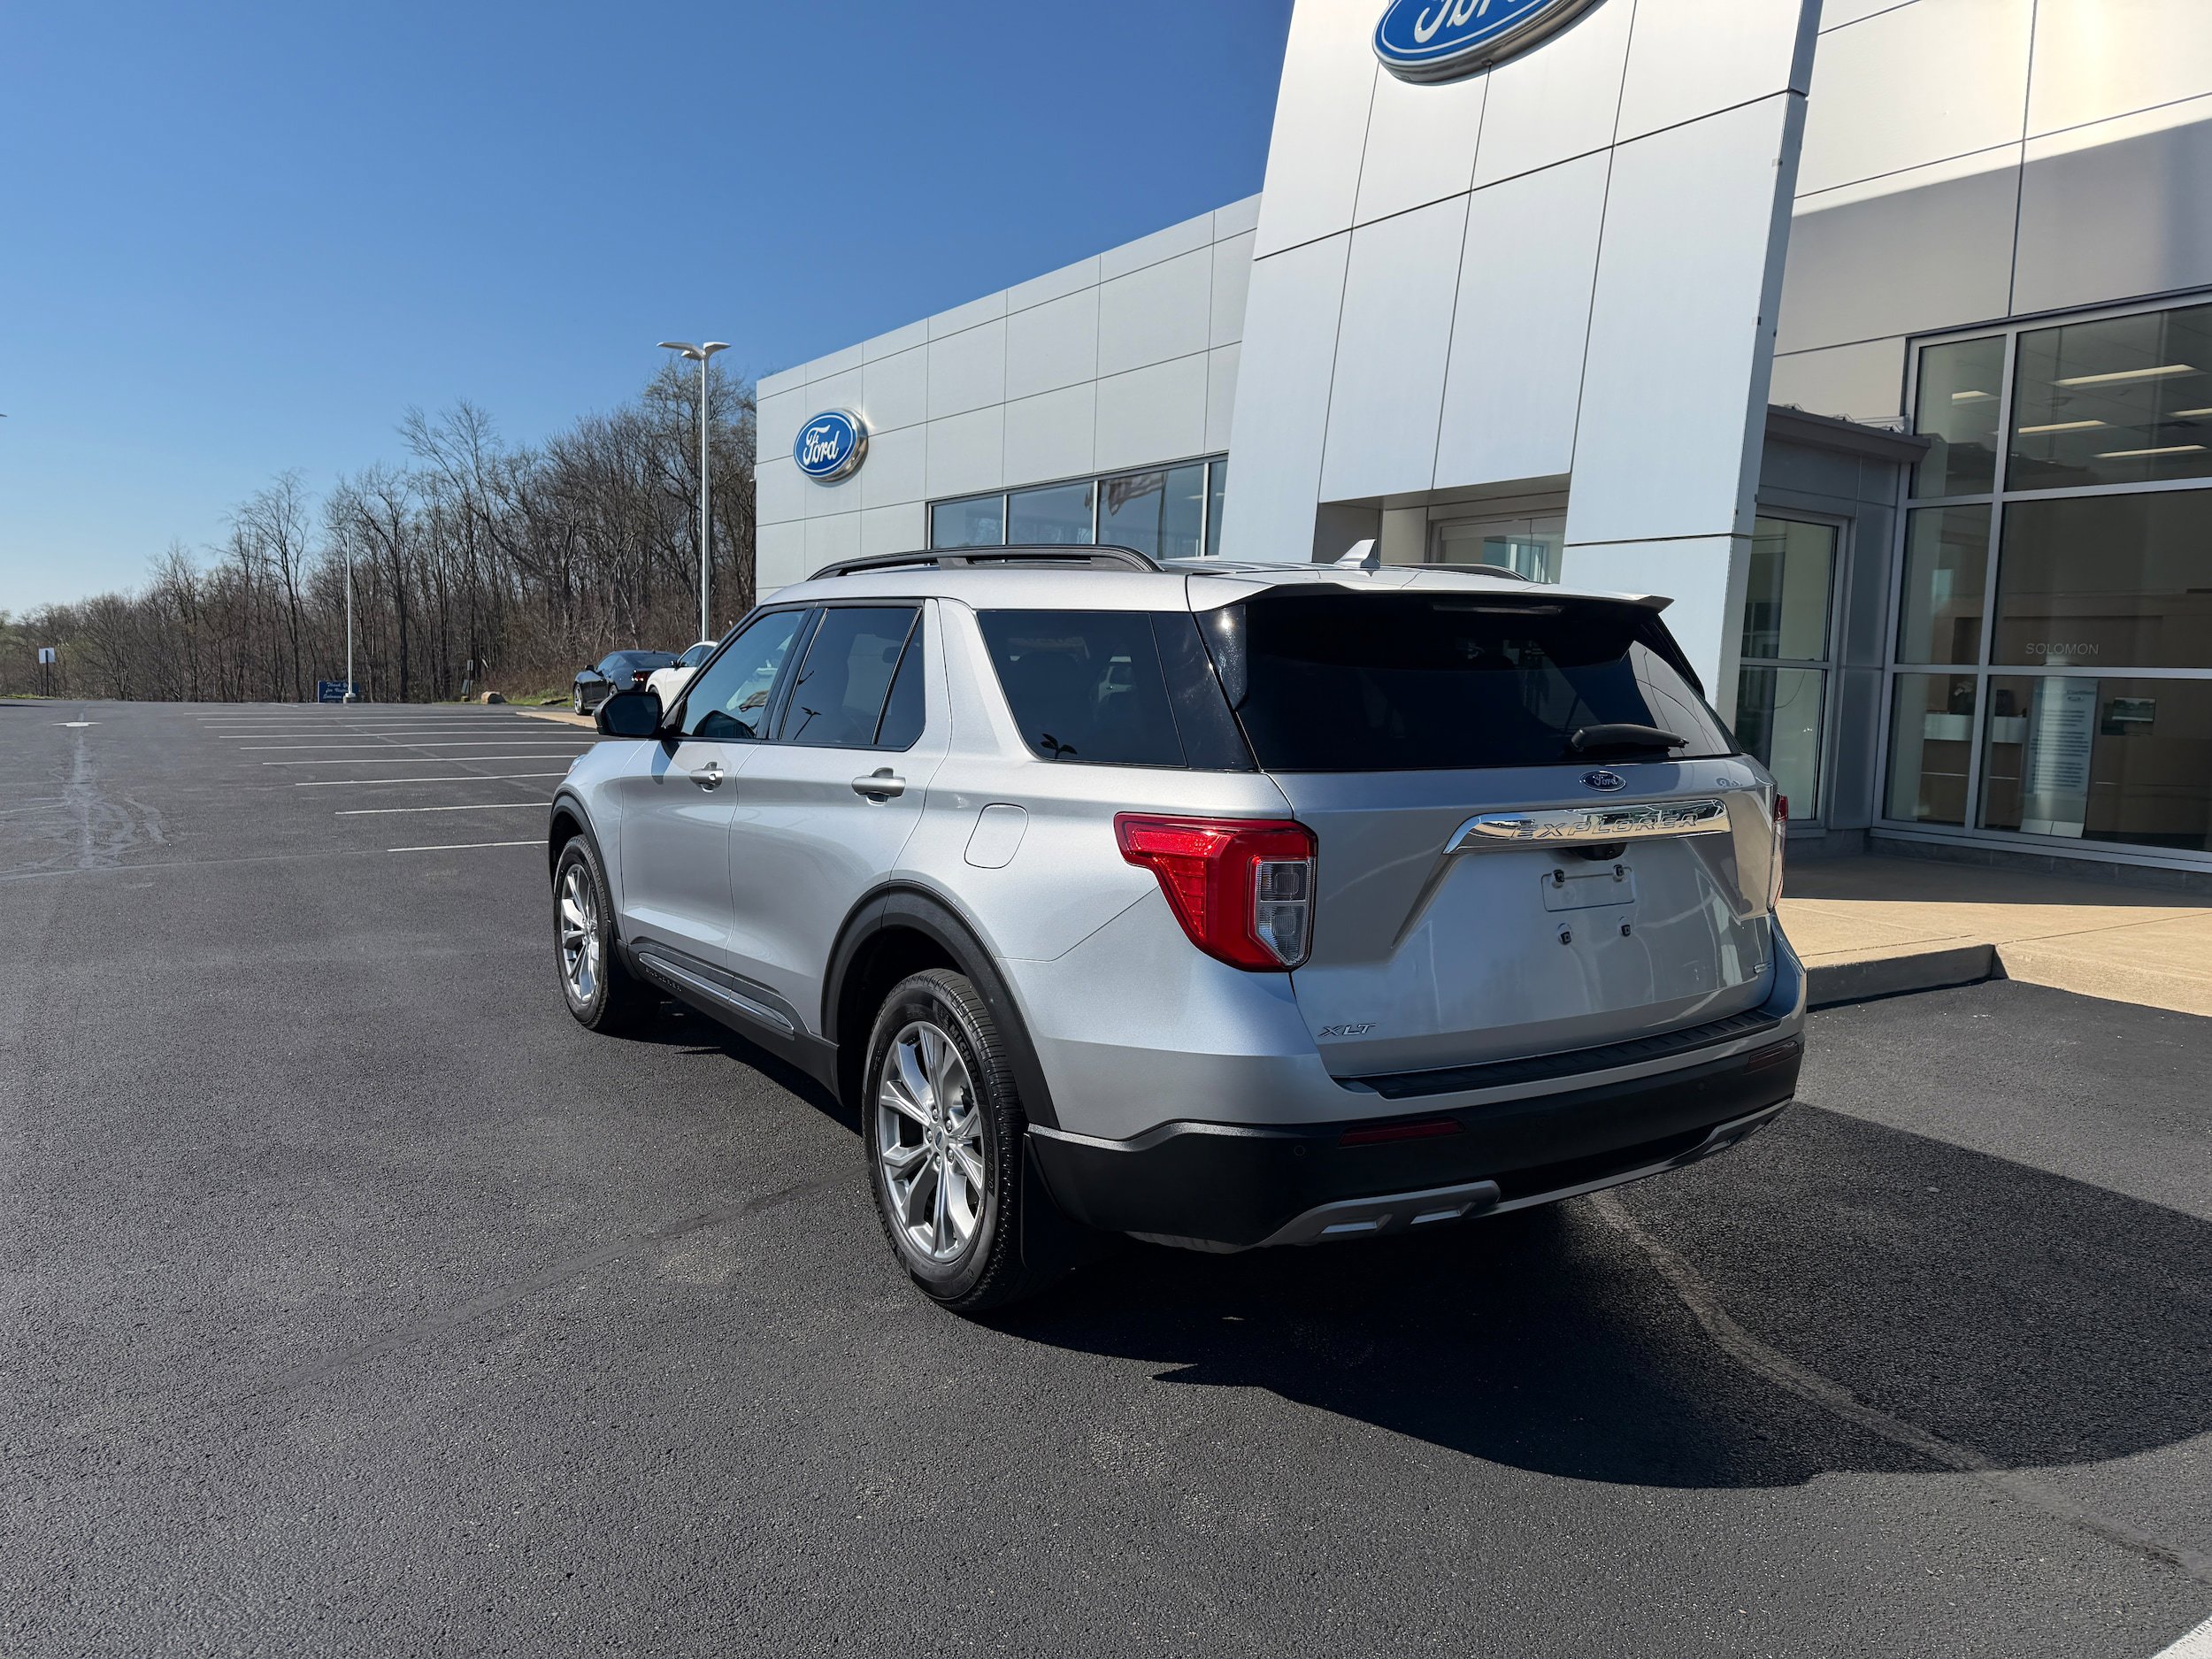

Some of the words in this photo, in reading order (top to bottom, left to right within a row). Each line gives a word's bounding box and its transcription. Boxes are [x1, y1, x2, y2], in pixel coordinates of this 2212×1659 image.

[803, 425, 840, 465] Ford
[2025, 642, 2100, 655] SOLOMON
[1594, 773, 1618, 786] Ford
[1509, 812, 1699, 841] EXPLORER
[1317, 1023, 1377, 1037] XLT
